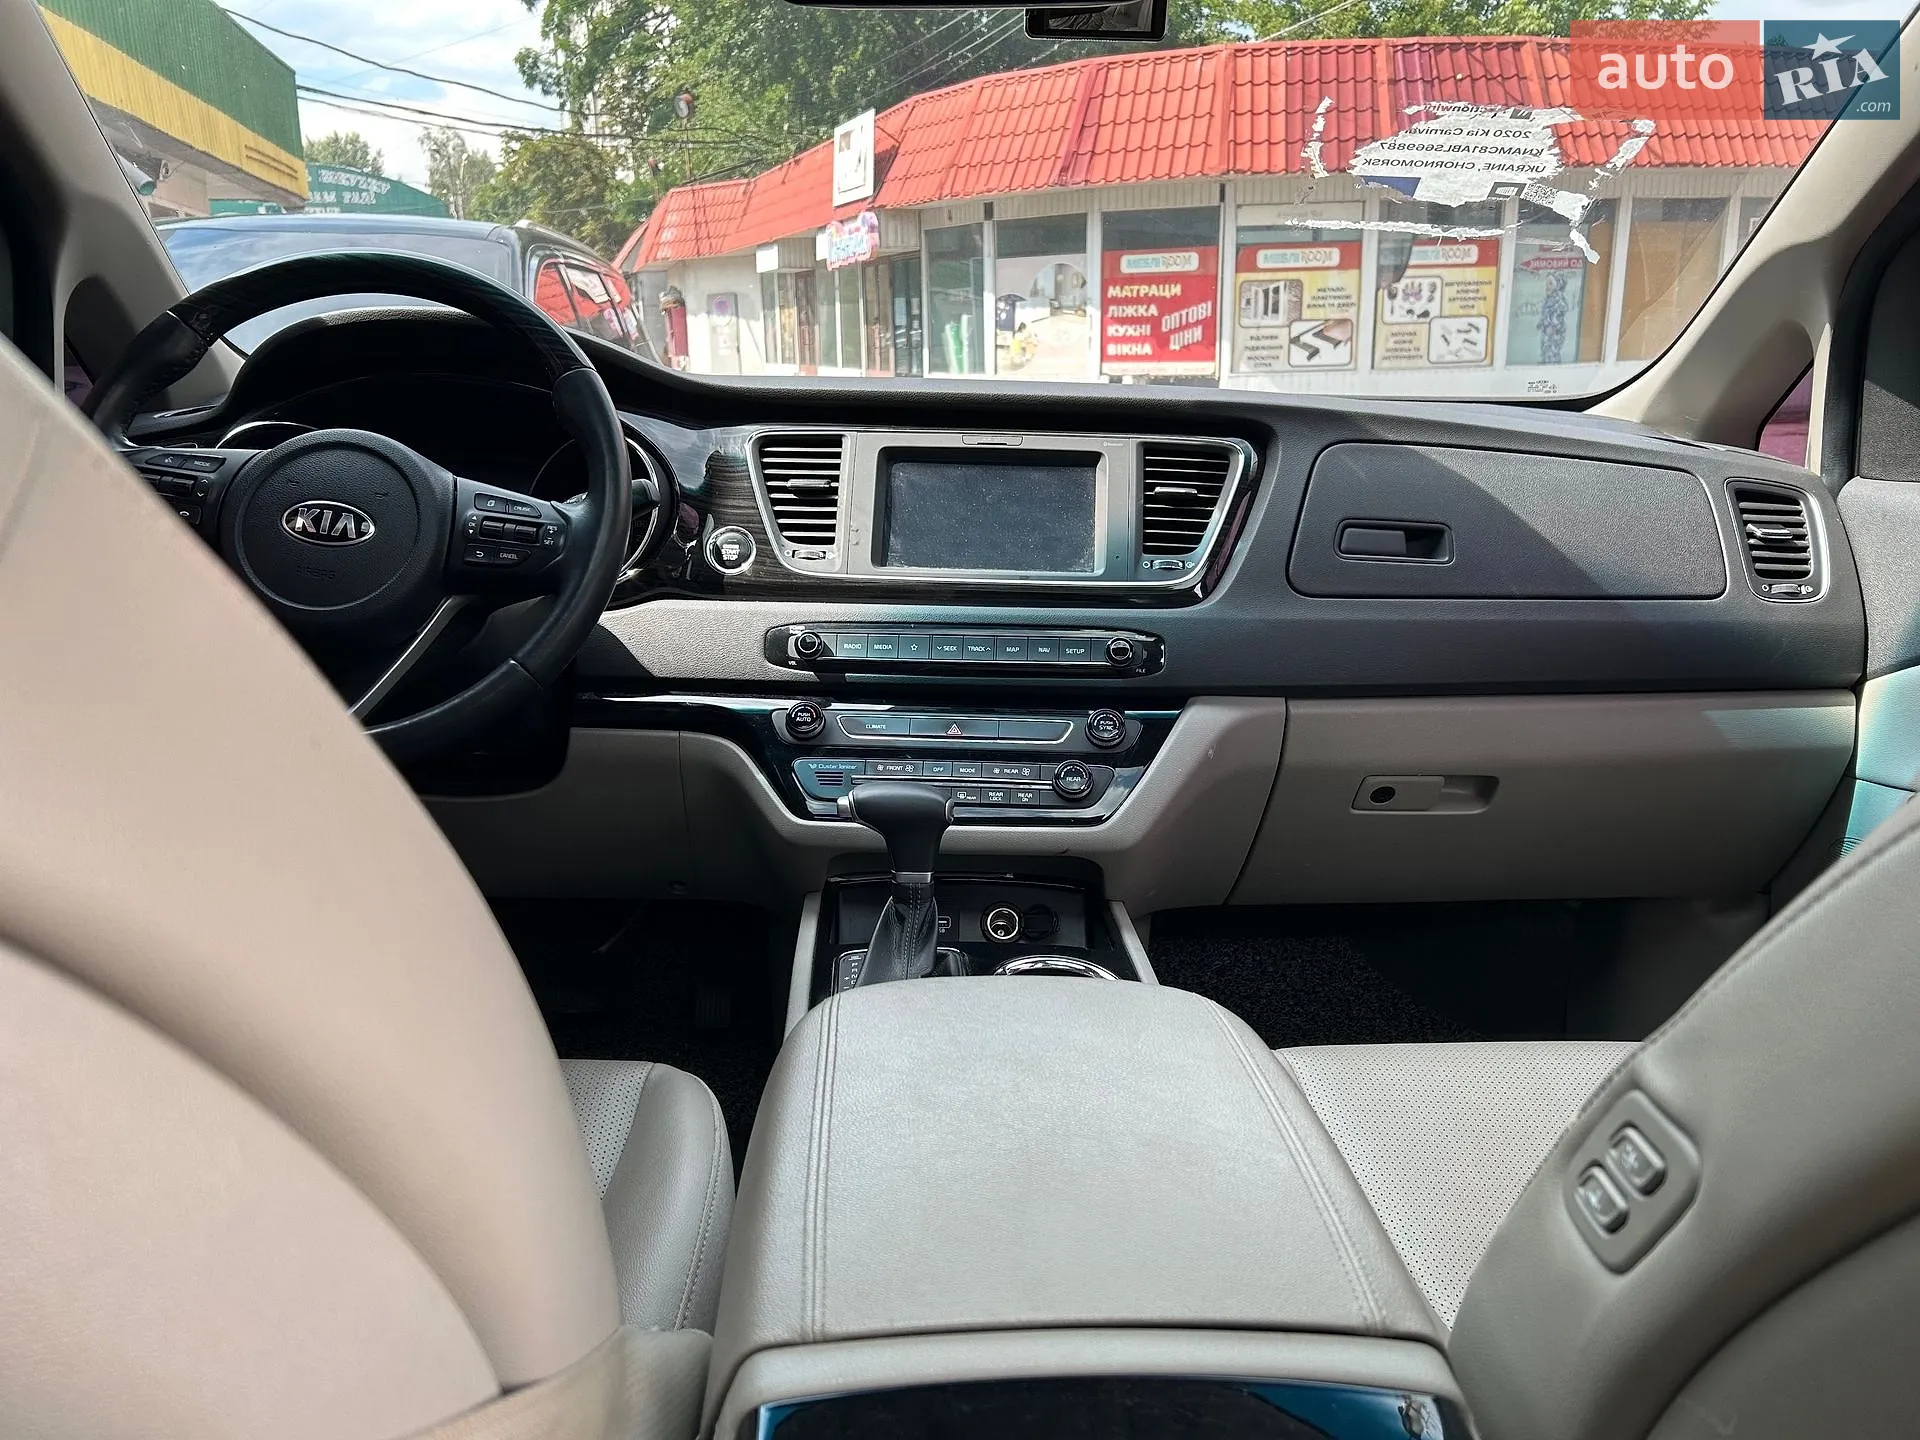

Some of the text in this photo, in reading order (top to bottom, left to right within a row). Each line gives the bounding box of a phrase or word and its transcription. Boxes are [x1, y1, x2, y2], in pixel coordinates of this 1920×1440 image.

[1107, 283, 1182, 299] МАТРАЦИ
[1106, 303, 1159, 318] ЛІЖКА
[1161, 300, 1213, 333] ОПТОВІ
[1106, 323, 1152, 337] КУХНІ
[1168, 325, 1203, 351] ЦІНИ
[1106, 342, 1153, 357] ВІКНА
[294, 507, 357, 539] KIA
